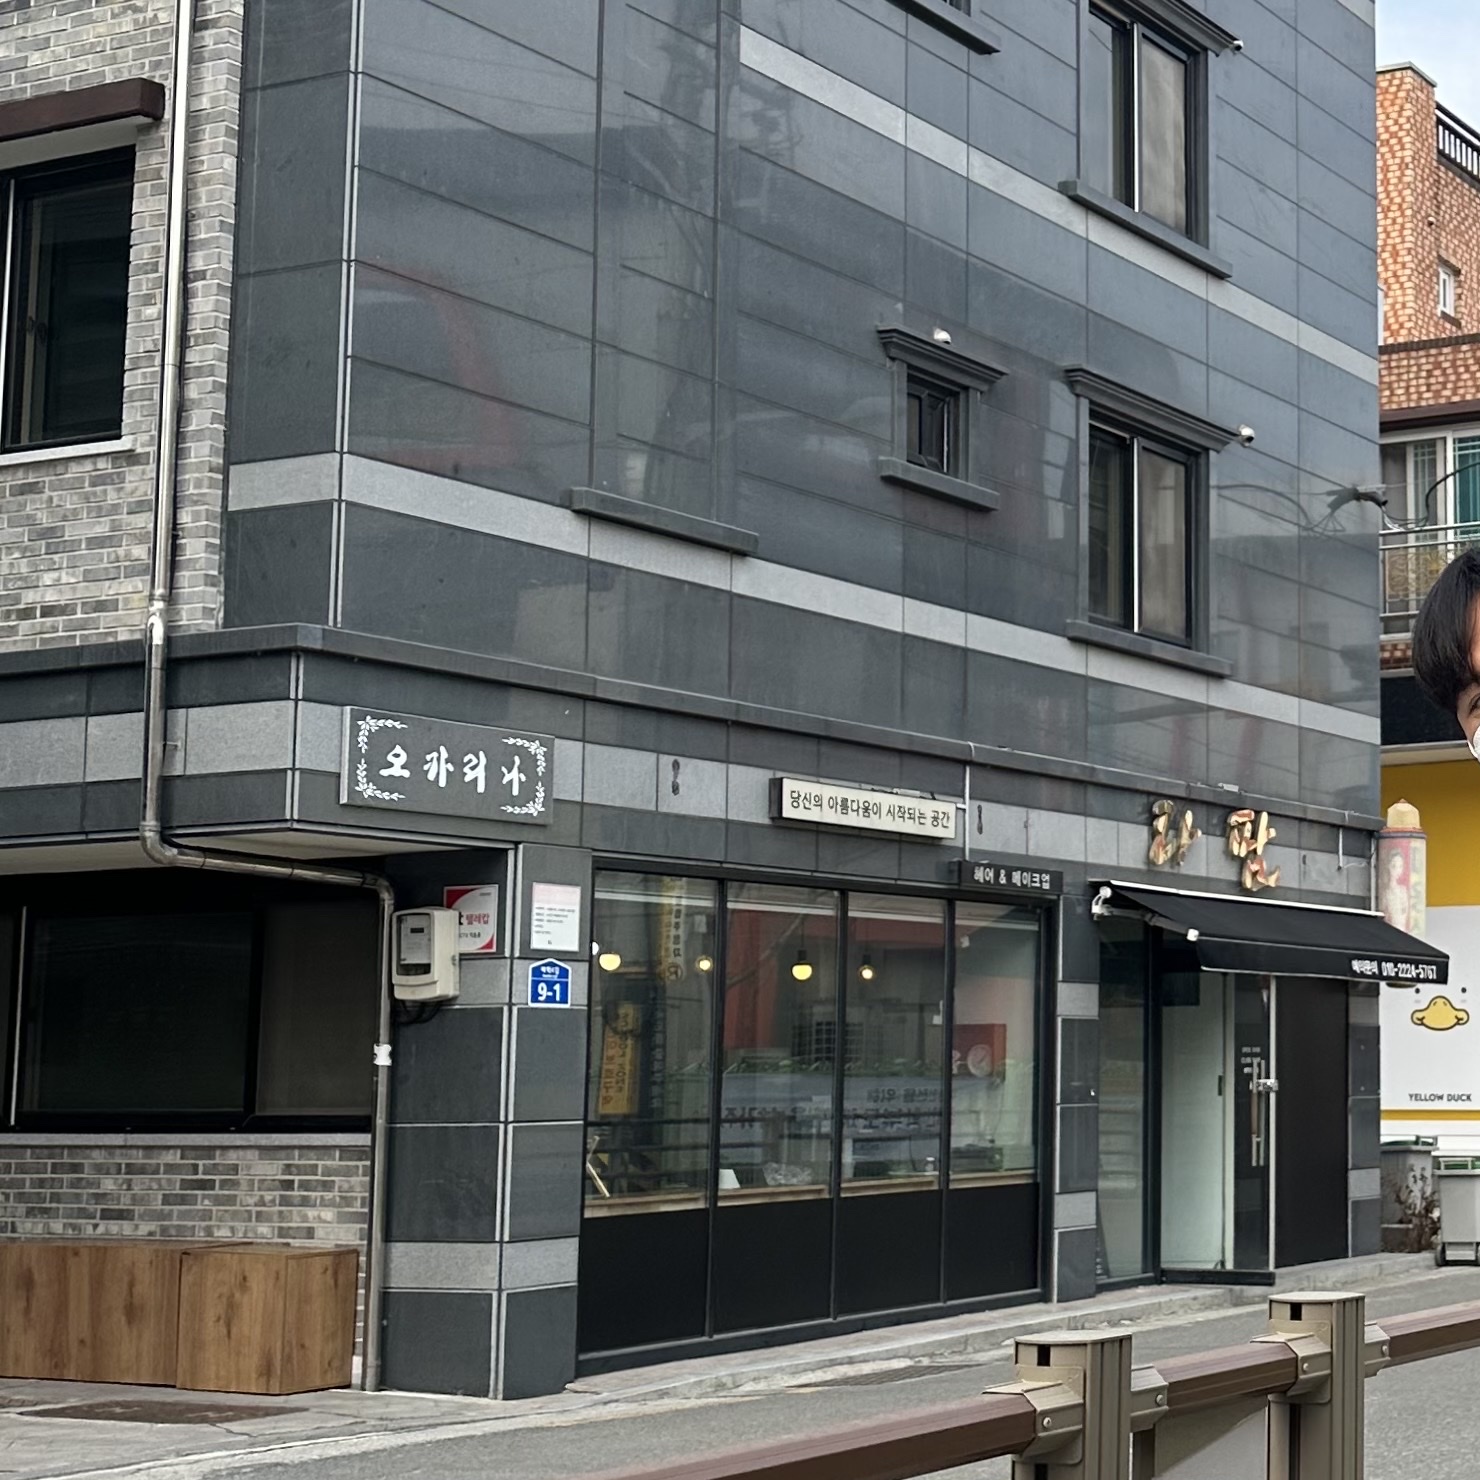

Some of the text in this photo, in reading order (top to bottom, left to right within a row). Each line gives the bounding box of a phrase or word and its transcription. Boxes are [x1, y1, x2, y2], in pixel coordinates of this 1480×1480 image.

[790, 789, 951, 829] 당신의 아름다움이 시작되는 공간
[973, 866, 1051, 890] 헤어 & 메이크업
[537, 982, 560, 1001] 9-1
[1408, 1093, 1472, 1102] YELLOW DUCK
